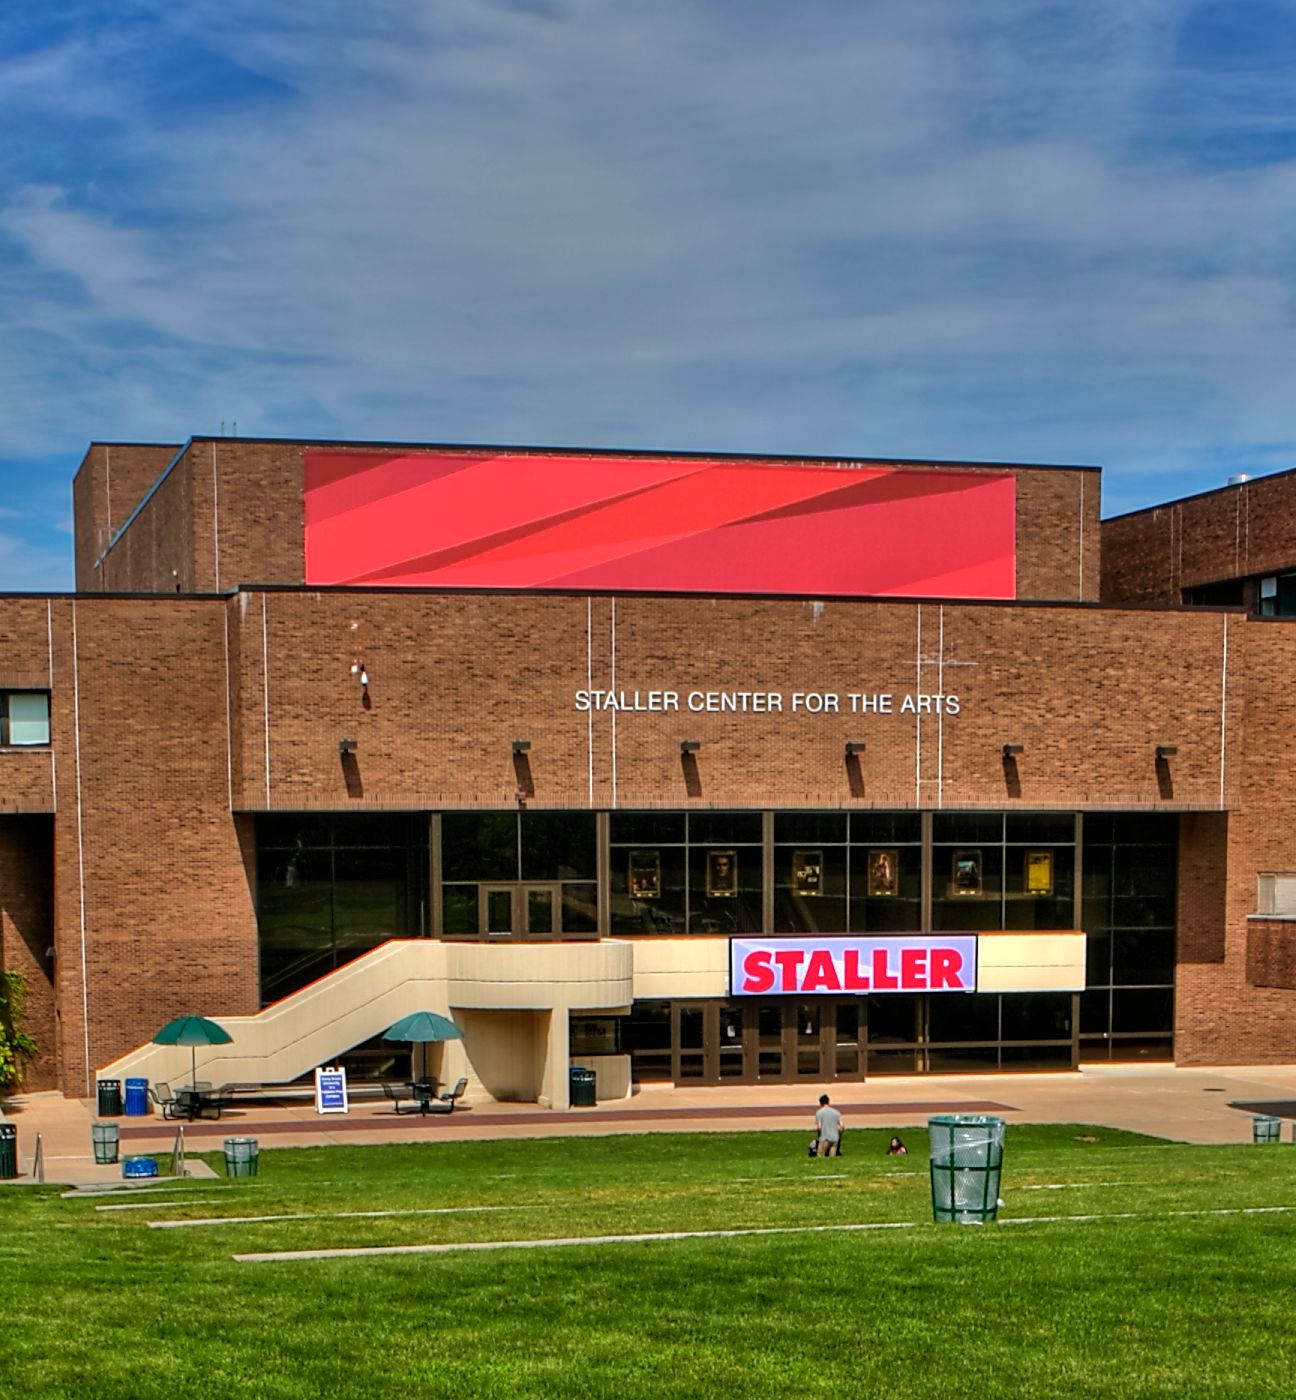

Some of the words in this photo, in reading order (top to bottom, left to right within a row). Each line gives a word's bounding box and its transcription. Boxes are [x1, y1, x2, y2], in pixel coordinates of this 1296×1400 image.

[575, 690, 679, 712] STALLER
[687, 691, 782, 712] CENTER
[792, 692, 839, 713] FOR
[848, 693, 892, 714] THE
[900, 694, 960, 715] ARTS
[742, 949, 964, 993] STALLER
